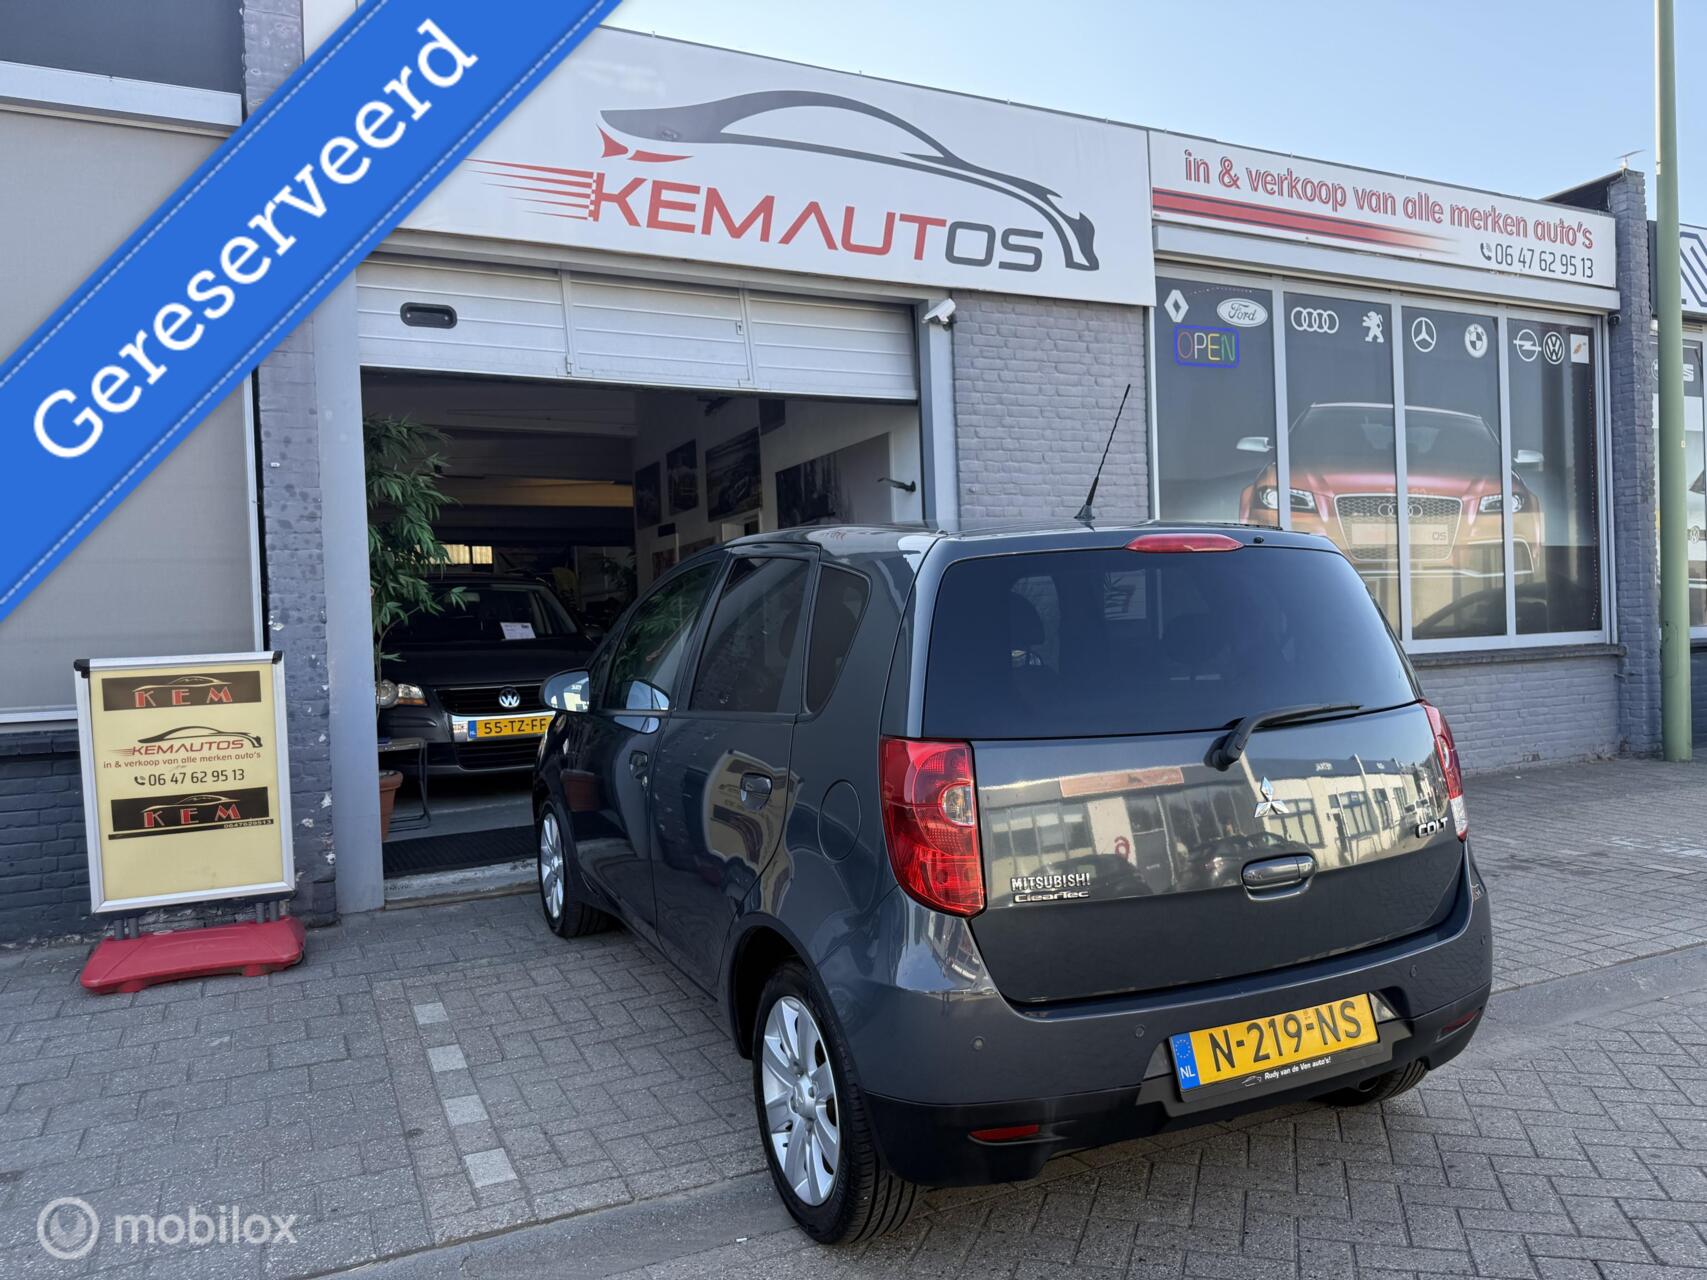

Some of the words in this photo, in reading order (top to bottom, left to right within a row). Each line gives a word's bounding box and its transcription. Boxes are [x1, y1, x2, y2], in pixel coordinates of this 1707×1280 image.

[1184, 149, 1210, 184] in
[1218, 156, 1241, 190] &
[1245, 168, 1347, 212] verkoop
[1353, 186, 1396, 216] van
[1403, 192, 1444, 224] alle
[1450, 203, 1528, 238] merken
[1533, 218, 1594, 249] auto's
[595, 172, 1044, 272] KEMAUTOS
[1495, 243, 1514, 266] 06
[1518, 248, 1535, 269] 47
[1539, 250, 1556, 273] 62
[1560, 254, 1577, 276] 95
[1580, 257, 1594, 279] 13
[1228, 302, 1258, 321] Ford
[1177, 331, 1236, 361] OPEN
[134, 686, 233, 708] KEM
[484, 718, 547, 735] 55-TZ-FF
[131, 739, 244, 756] KEMAUTOS
[103, 760, 112, 769] in
[114, 760, 122, 768] &
[124, 759, 160, 768] verkoop
[162, 757, 179, 765] van
[181, 755, 197, 764] alle
[200, 753, 233, 763] merken
[235, 751, 261, 760] auto's
[148, 773, 166, 786] 06
[170, 772, 187, 785] 47
[191, 771, 208, 784] 62
[212, 769, 228, 782] 95
[233, 768, 245, 781] 13
[143, 803, 241, 828] KEM
[1415, 817, 1448, 838] COLT
[1011, 873, 1091, 891] MITSUBISHI
[1014, 891, 1089, 903] ClearTec
[1208, 1000, 1362, 1073] N-219-NS
[1179, 1064, 1196, 1080] NL
[1264, 1071, 1280, 1080] Rudy
[1280, 1068, 1291, 1076] van
[1291, 1065, 1299, 1073] de
